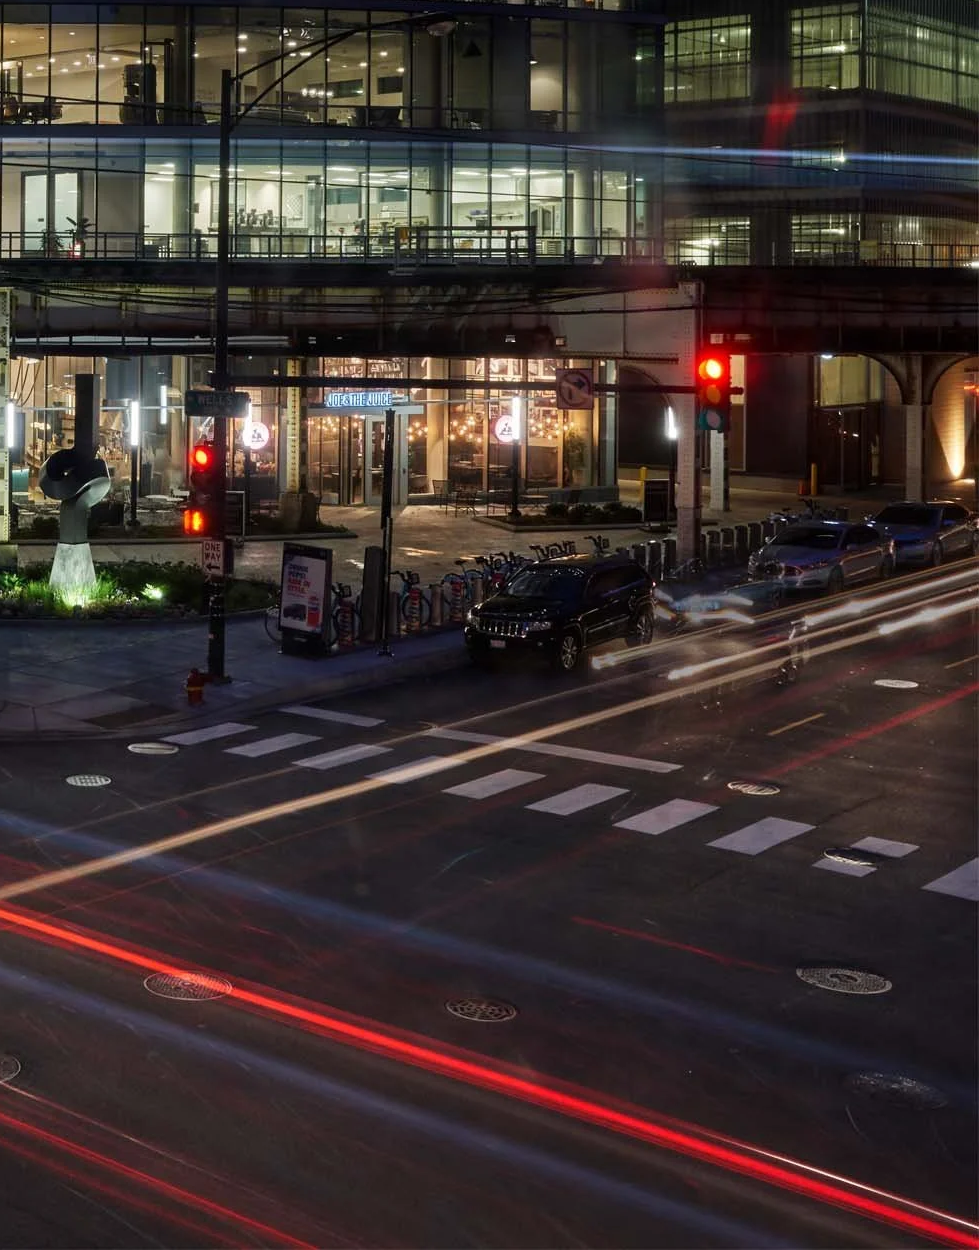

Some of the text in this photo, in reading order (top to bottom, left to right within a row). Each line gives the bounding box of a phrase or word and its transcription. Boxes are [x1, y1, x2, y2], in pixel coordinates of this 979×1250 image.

[350, 392, 366, 406] THE
[367, 391, 392, 406] JUICE
[204, 542, 221, 552] ONE
[204, 552, 221, 562] WAY
